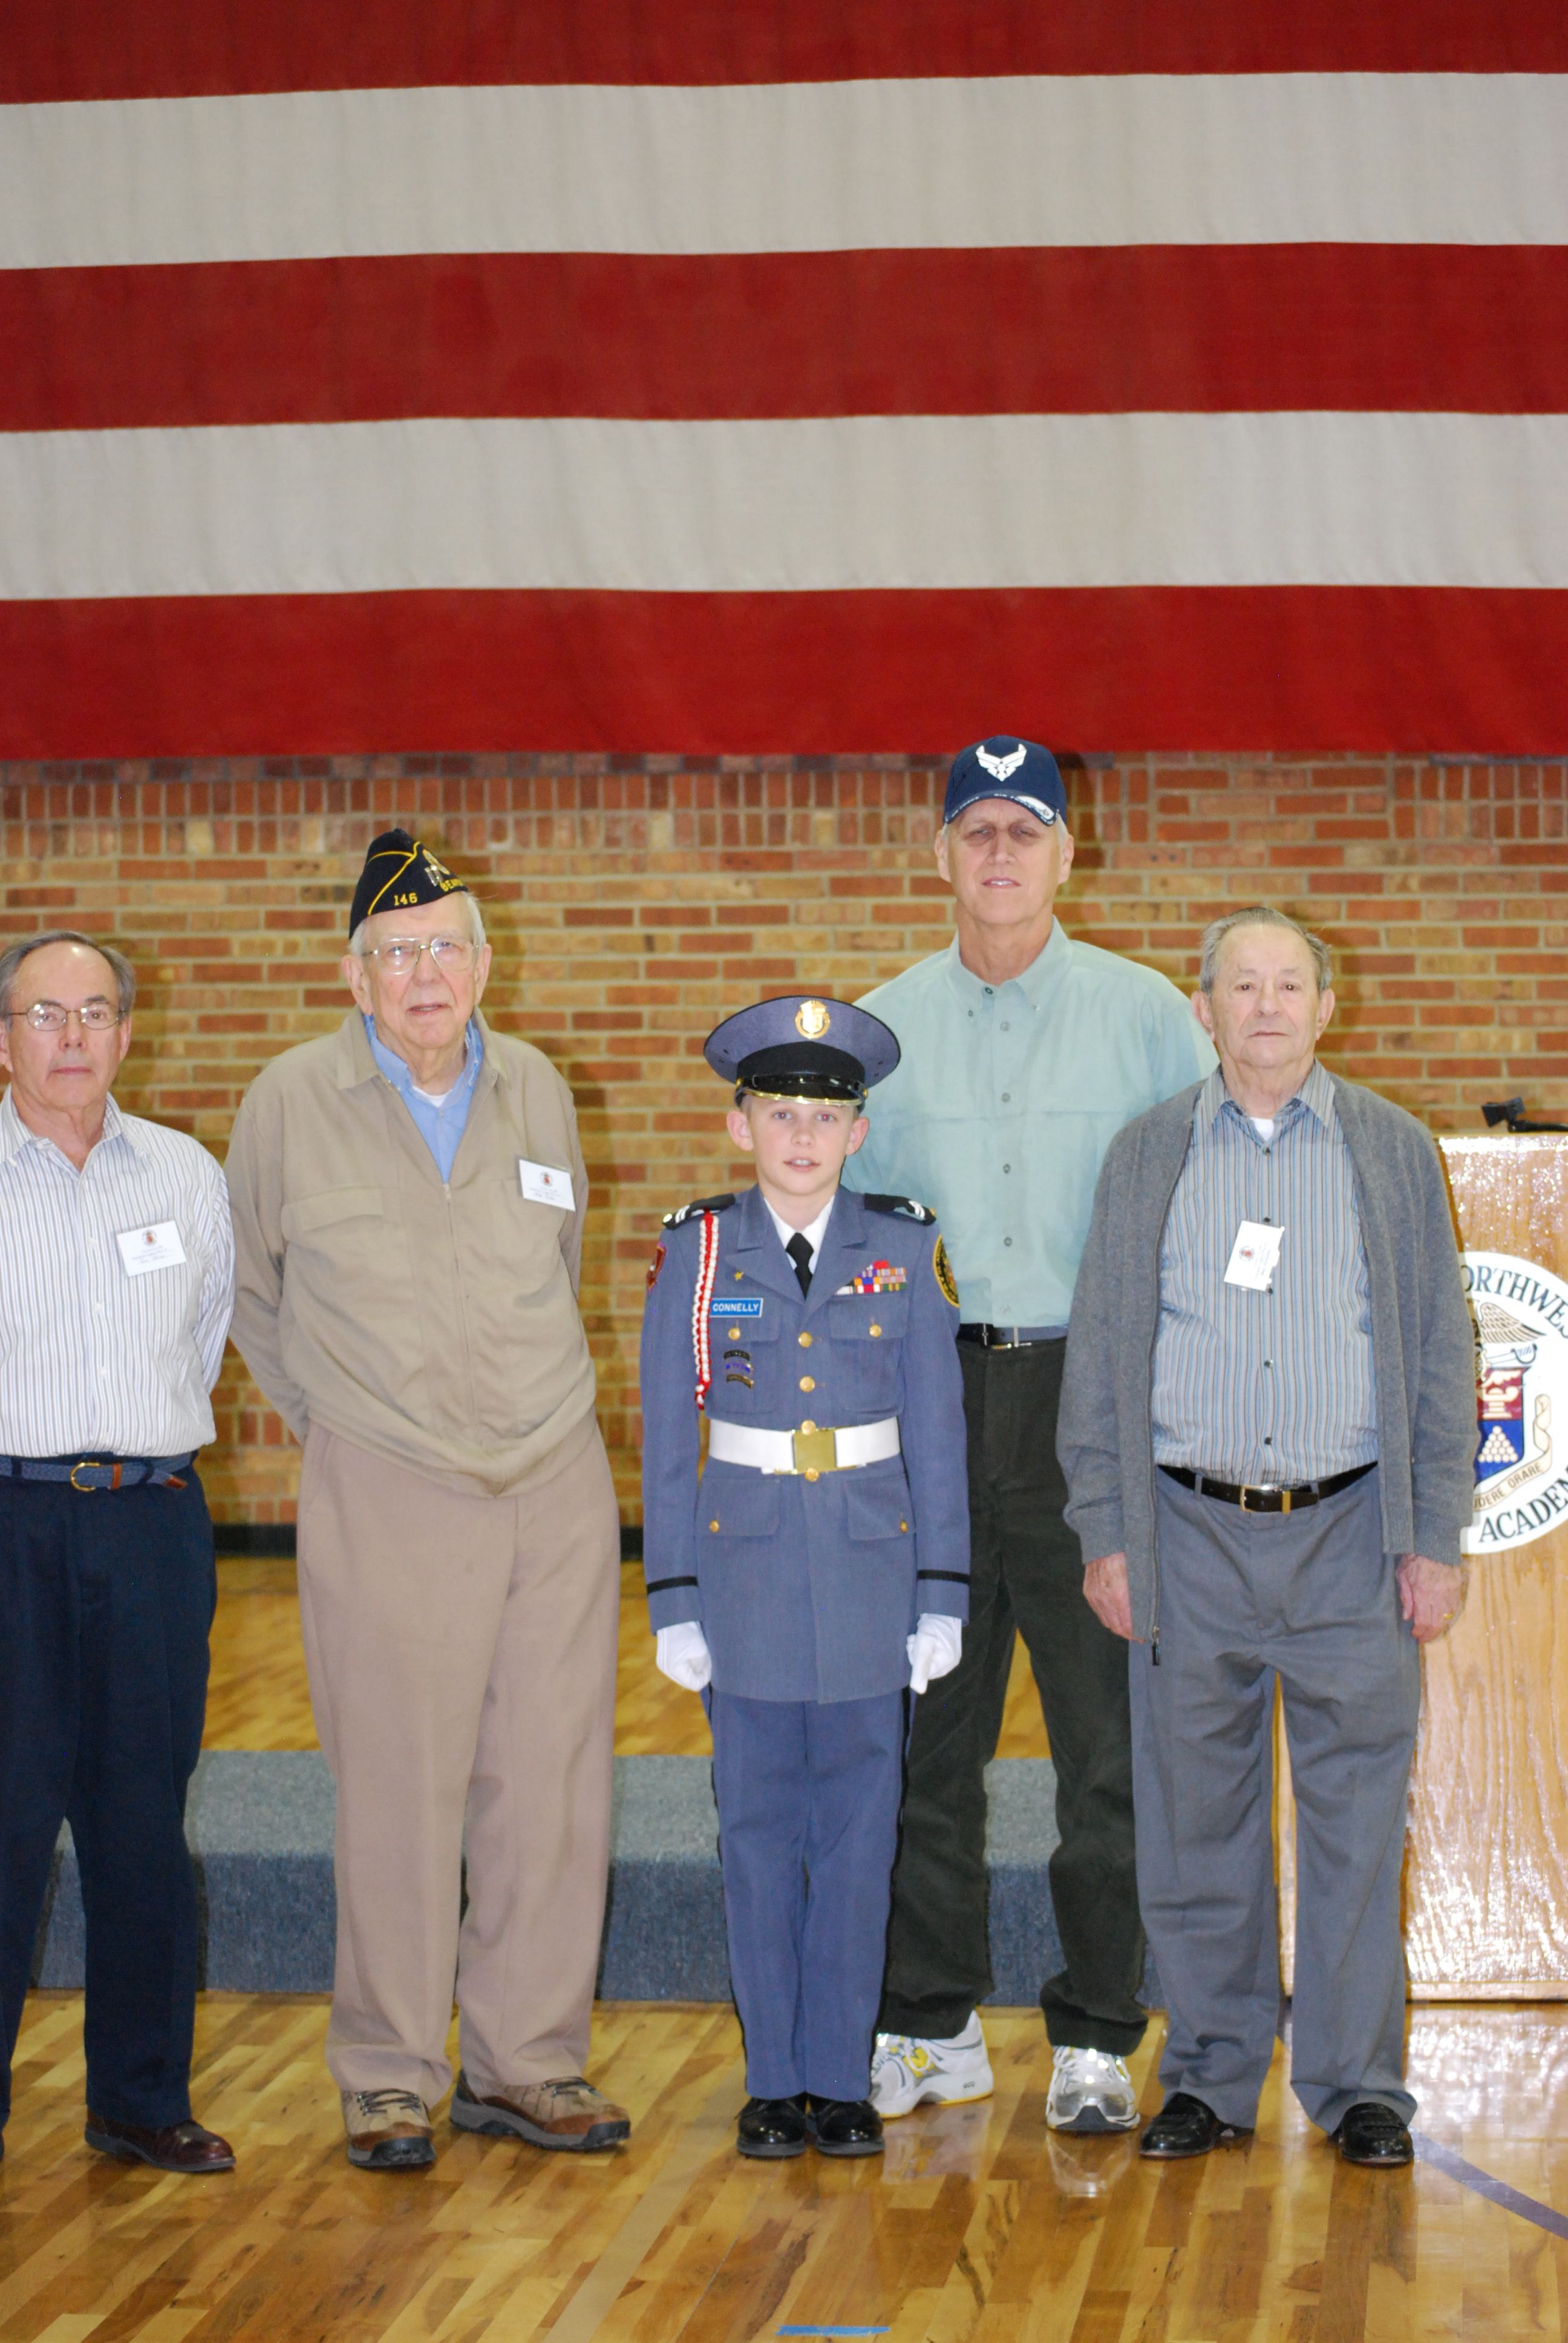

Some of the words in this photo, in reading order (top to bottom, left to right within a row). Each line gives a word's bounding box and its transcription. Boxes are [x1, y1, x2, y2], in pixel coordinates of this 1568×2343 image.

[393, 892, 417, 906] 146
[713, 1303, 759, 1312] CONNELLY
[1460, 1265, 1568, 1339] ORTHWE
[1507, 1462, 1543, 1489] ORARE
